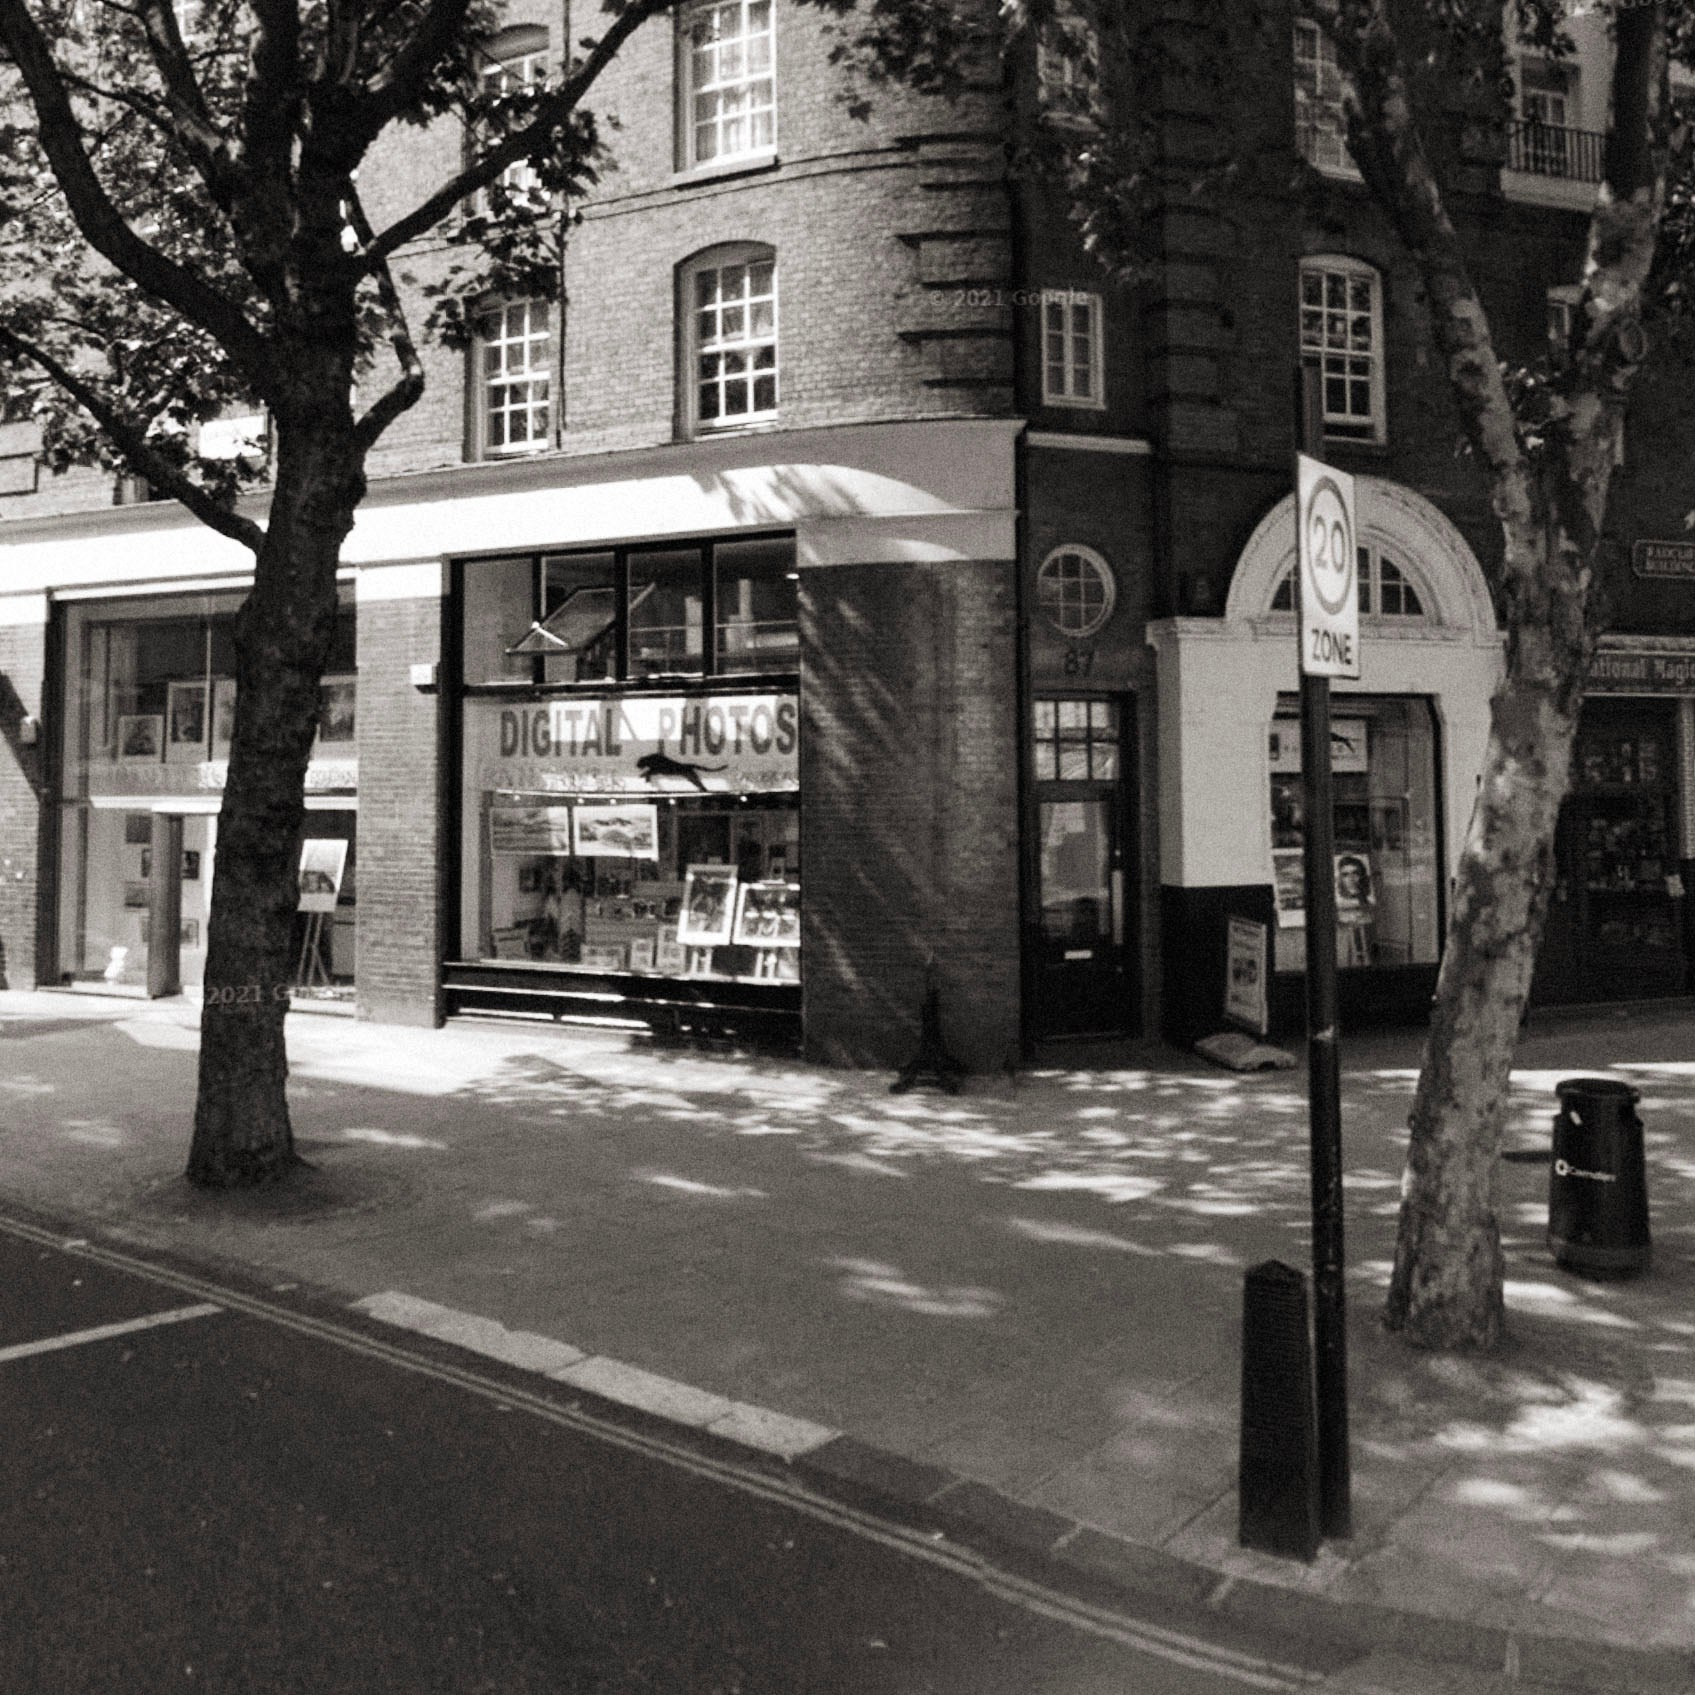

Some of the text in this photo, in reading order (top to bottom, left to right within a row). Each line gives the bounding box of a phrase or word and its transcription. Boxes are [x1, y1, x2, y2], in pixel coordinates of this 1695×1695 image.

[1313, 514, 1346, 574] 20
[1064, 648, 1095, 677] 87
[1312, 627, 1353, 666] ZONE
[500, 700, 798, 758] DIGITAL PHOTOS
